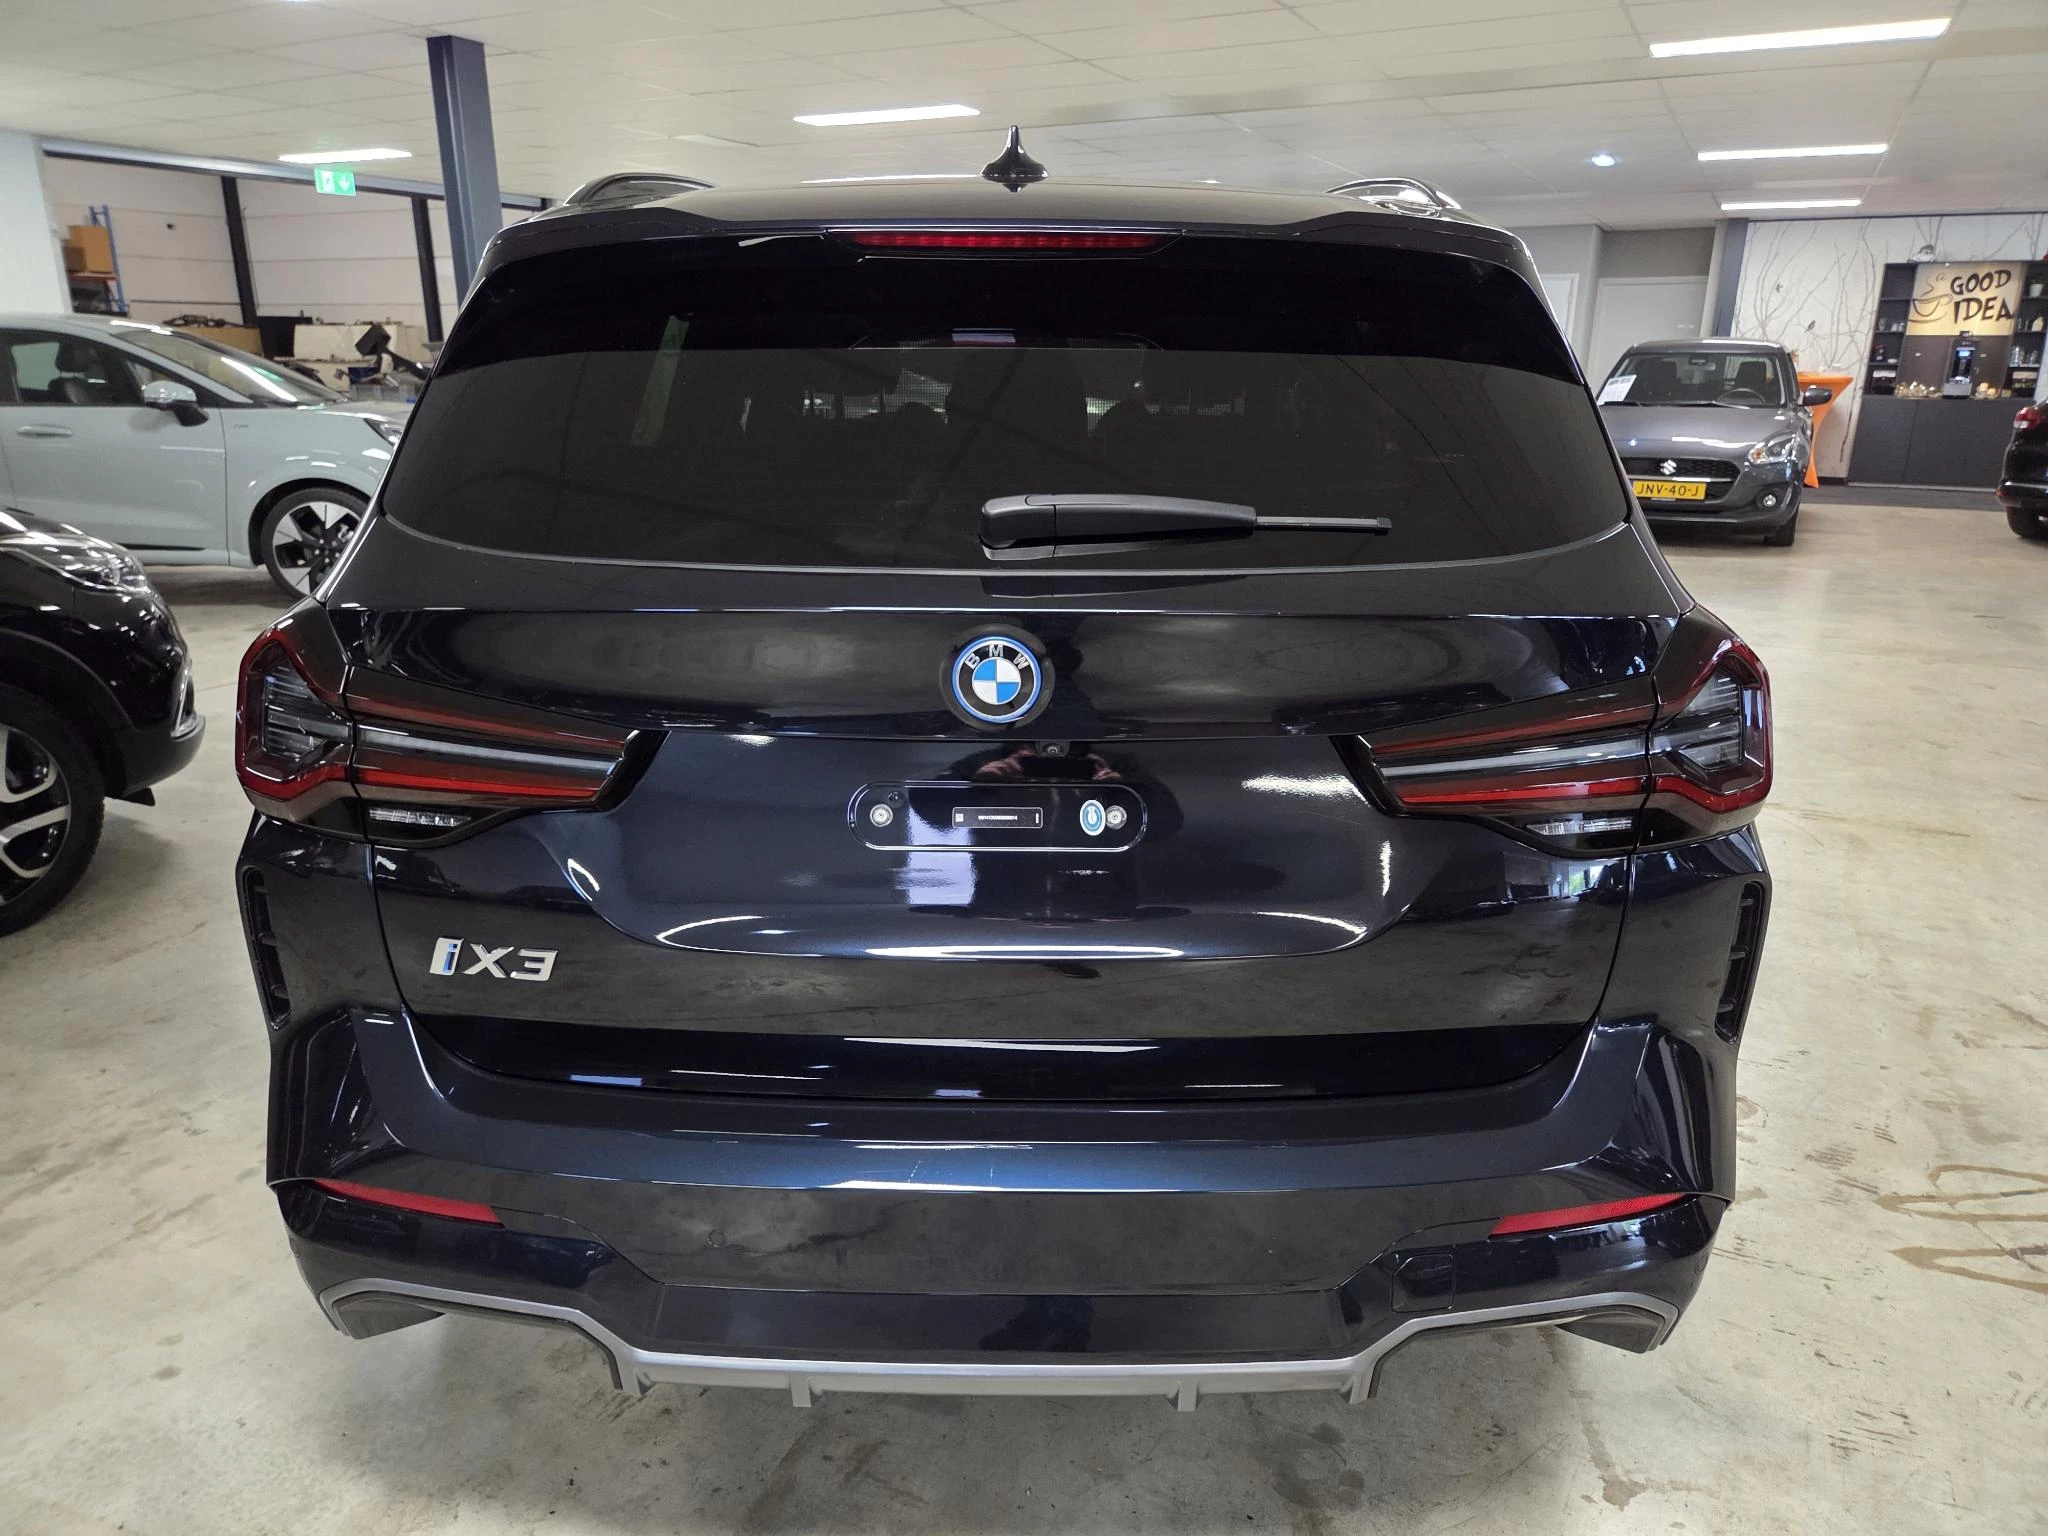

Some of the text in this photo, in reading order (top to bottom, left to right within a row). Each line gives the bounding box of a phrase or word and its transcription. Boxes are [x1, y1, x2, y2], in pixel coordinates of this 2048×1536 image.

[1950, 269, 2012, 296] GOOD
[1954, 296, 2014, 325] IDEA
[1637, 483, 1699, 497] JNV-40-J
[964, 644, 1030, 670] BMW
[429, 937, 558, 982] iX3
